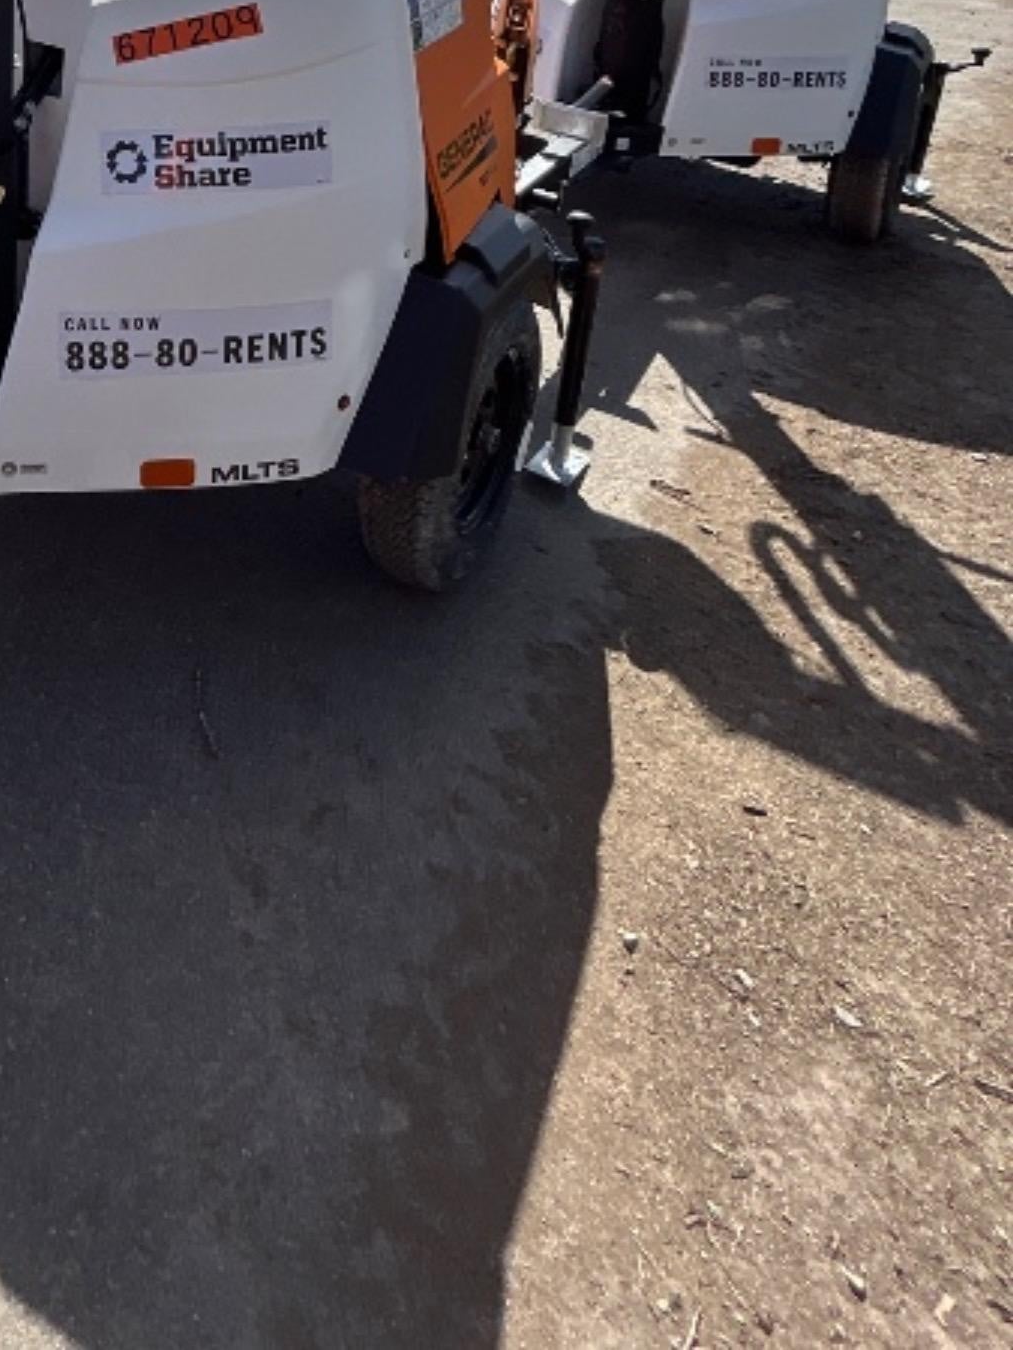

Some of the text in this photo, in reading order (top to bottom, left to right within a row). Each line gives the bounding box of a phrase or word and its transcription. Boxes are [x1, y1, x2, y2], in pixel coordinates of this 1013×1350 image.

[118, 5, 260, 62] 671209
[152, 126, 328, 163] Equipment
[153, 163, 252, 190] Share
[63, 316, 162, 332] CALL NOW
[65, 325, 328, 372] 888-80-RENTS
[210, 458, 301, 484] MLTS
